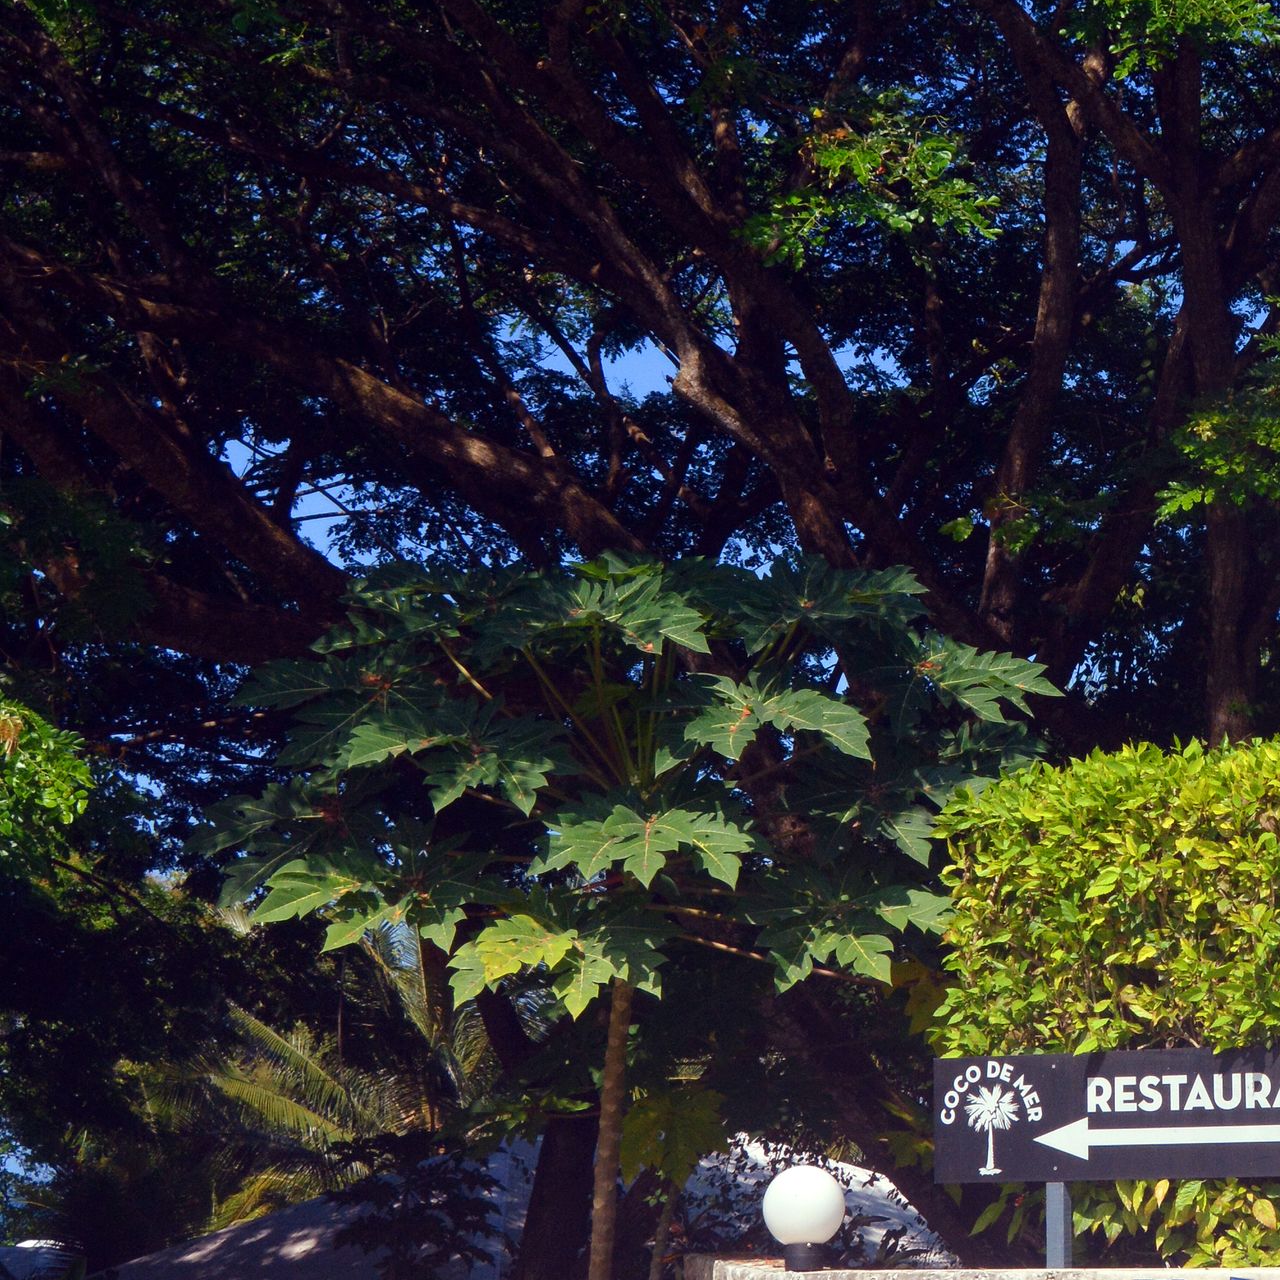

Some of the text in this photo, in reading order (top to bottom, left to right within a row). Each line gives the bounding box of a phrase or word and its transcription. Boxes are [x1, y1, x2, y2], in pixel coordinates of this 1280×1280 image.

[940, 1060, 1042, 1125] COCO DE MER
